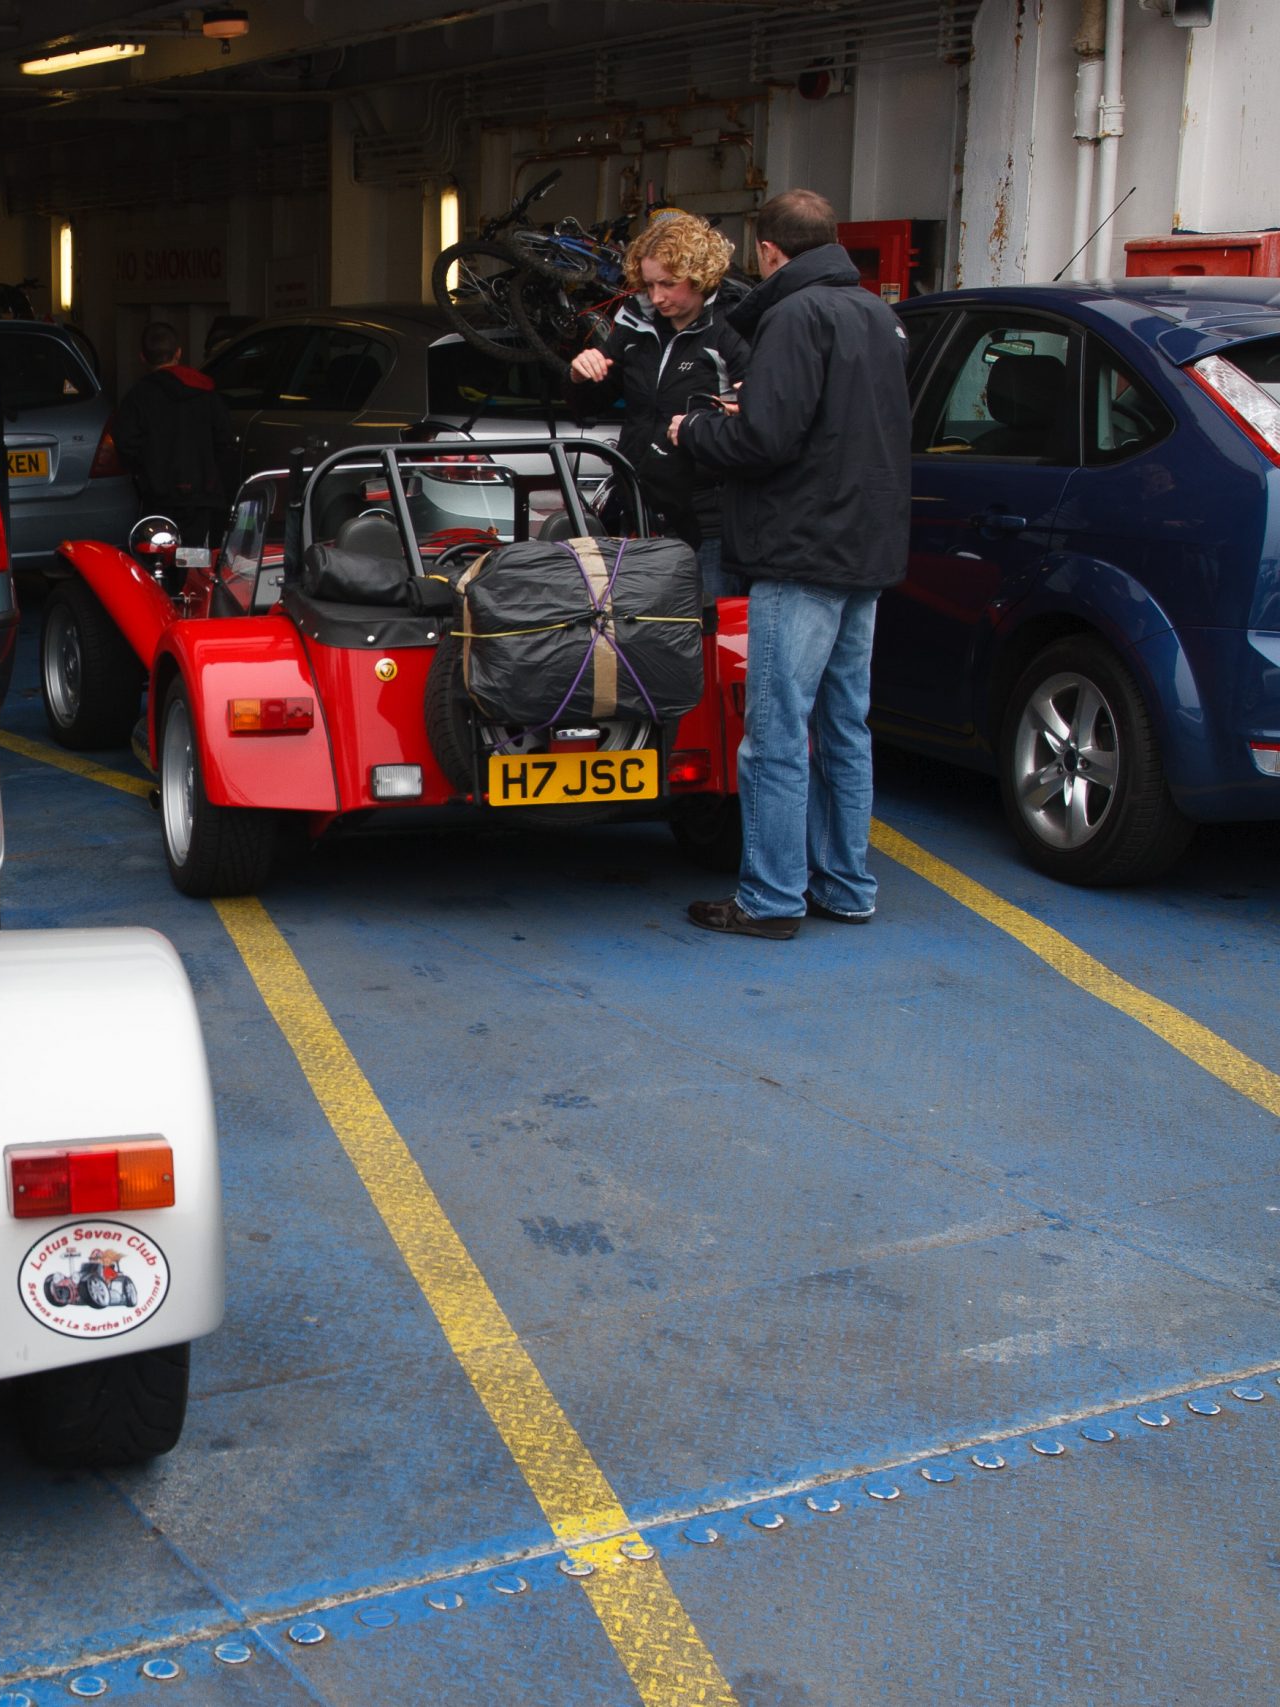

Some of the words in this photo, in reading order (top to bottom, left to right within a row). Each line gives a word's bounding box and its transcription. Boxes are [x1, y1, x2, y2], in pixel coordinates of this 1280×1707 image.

[144, 248, 223, 281] SMOKING
[502, 761, 558, 800] H7
[562, 758, 646, 797] JSC
[30, 1236, 69, 1271] Lotus
[73, 1228, 123, 1242] Seven
[127, 1235, 158, 1267] Club
[27, 1282, 52, 1318] Sevens
[53, 1316, 64, 1325] at
[66, 1320, 80, 1331] La
[83, 1322, 120, 1333] Sarthe
[123, 1316, 133, 1325] in
[135, 1274, 162, 1318] Summer
